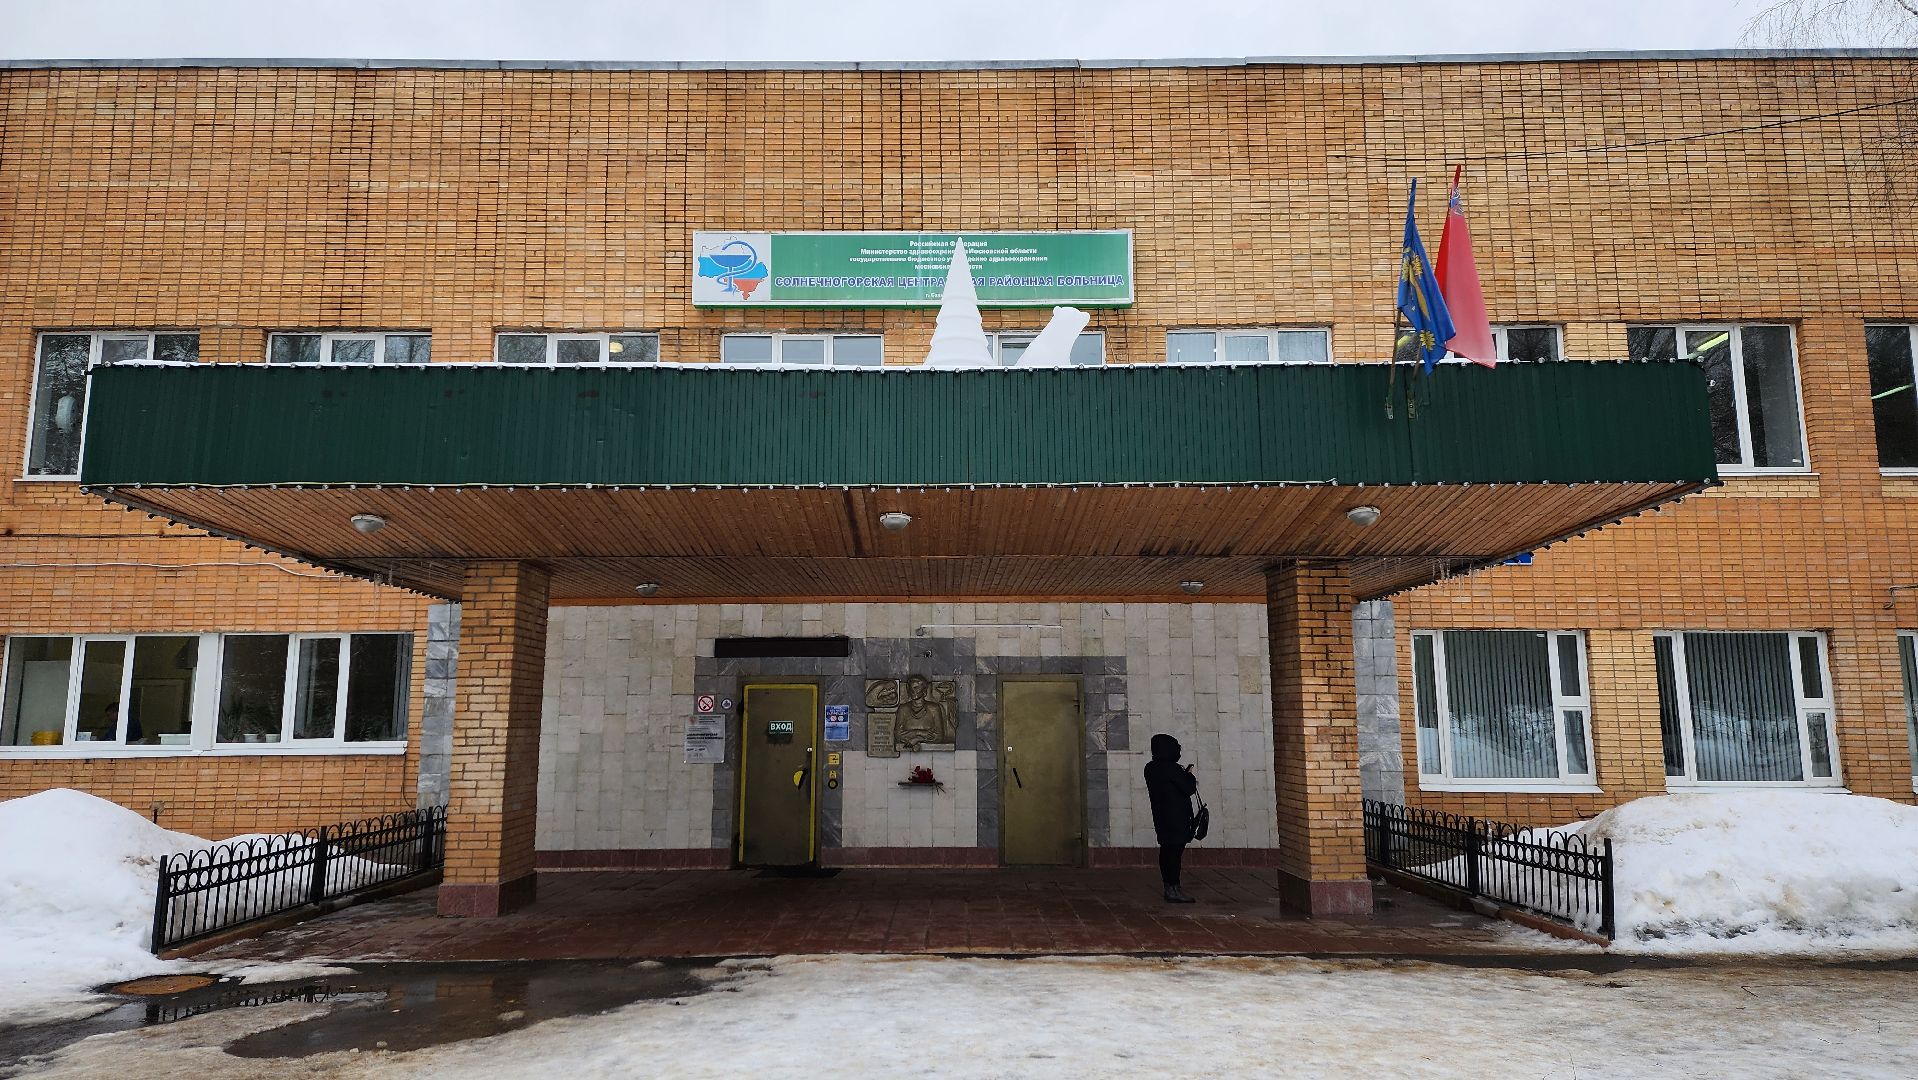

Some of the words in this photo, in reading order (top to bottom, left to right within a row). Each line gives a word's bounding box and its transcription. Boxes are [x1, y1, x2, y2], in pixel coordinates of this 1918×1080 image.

[950, 240, 988, 248] Ферация
[860, 248, 908, 256] Министерство
[775, 276, 895, 288] СОЛНЕЧНОГОРСКАЯ
[898, 276, 986, 288] ЦЕНТРААЯ
[988, 274, 1054, 287] РАЙОННАЯ
[1057, 274, 1124, 288] БОЛЬНИЦА
[770, 723, 792, 731] ВХОД
